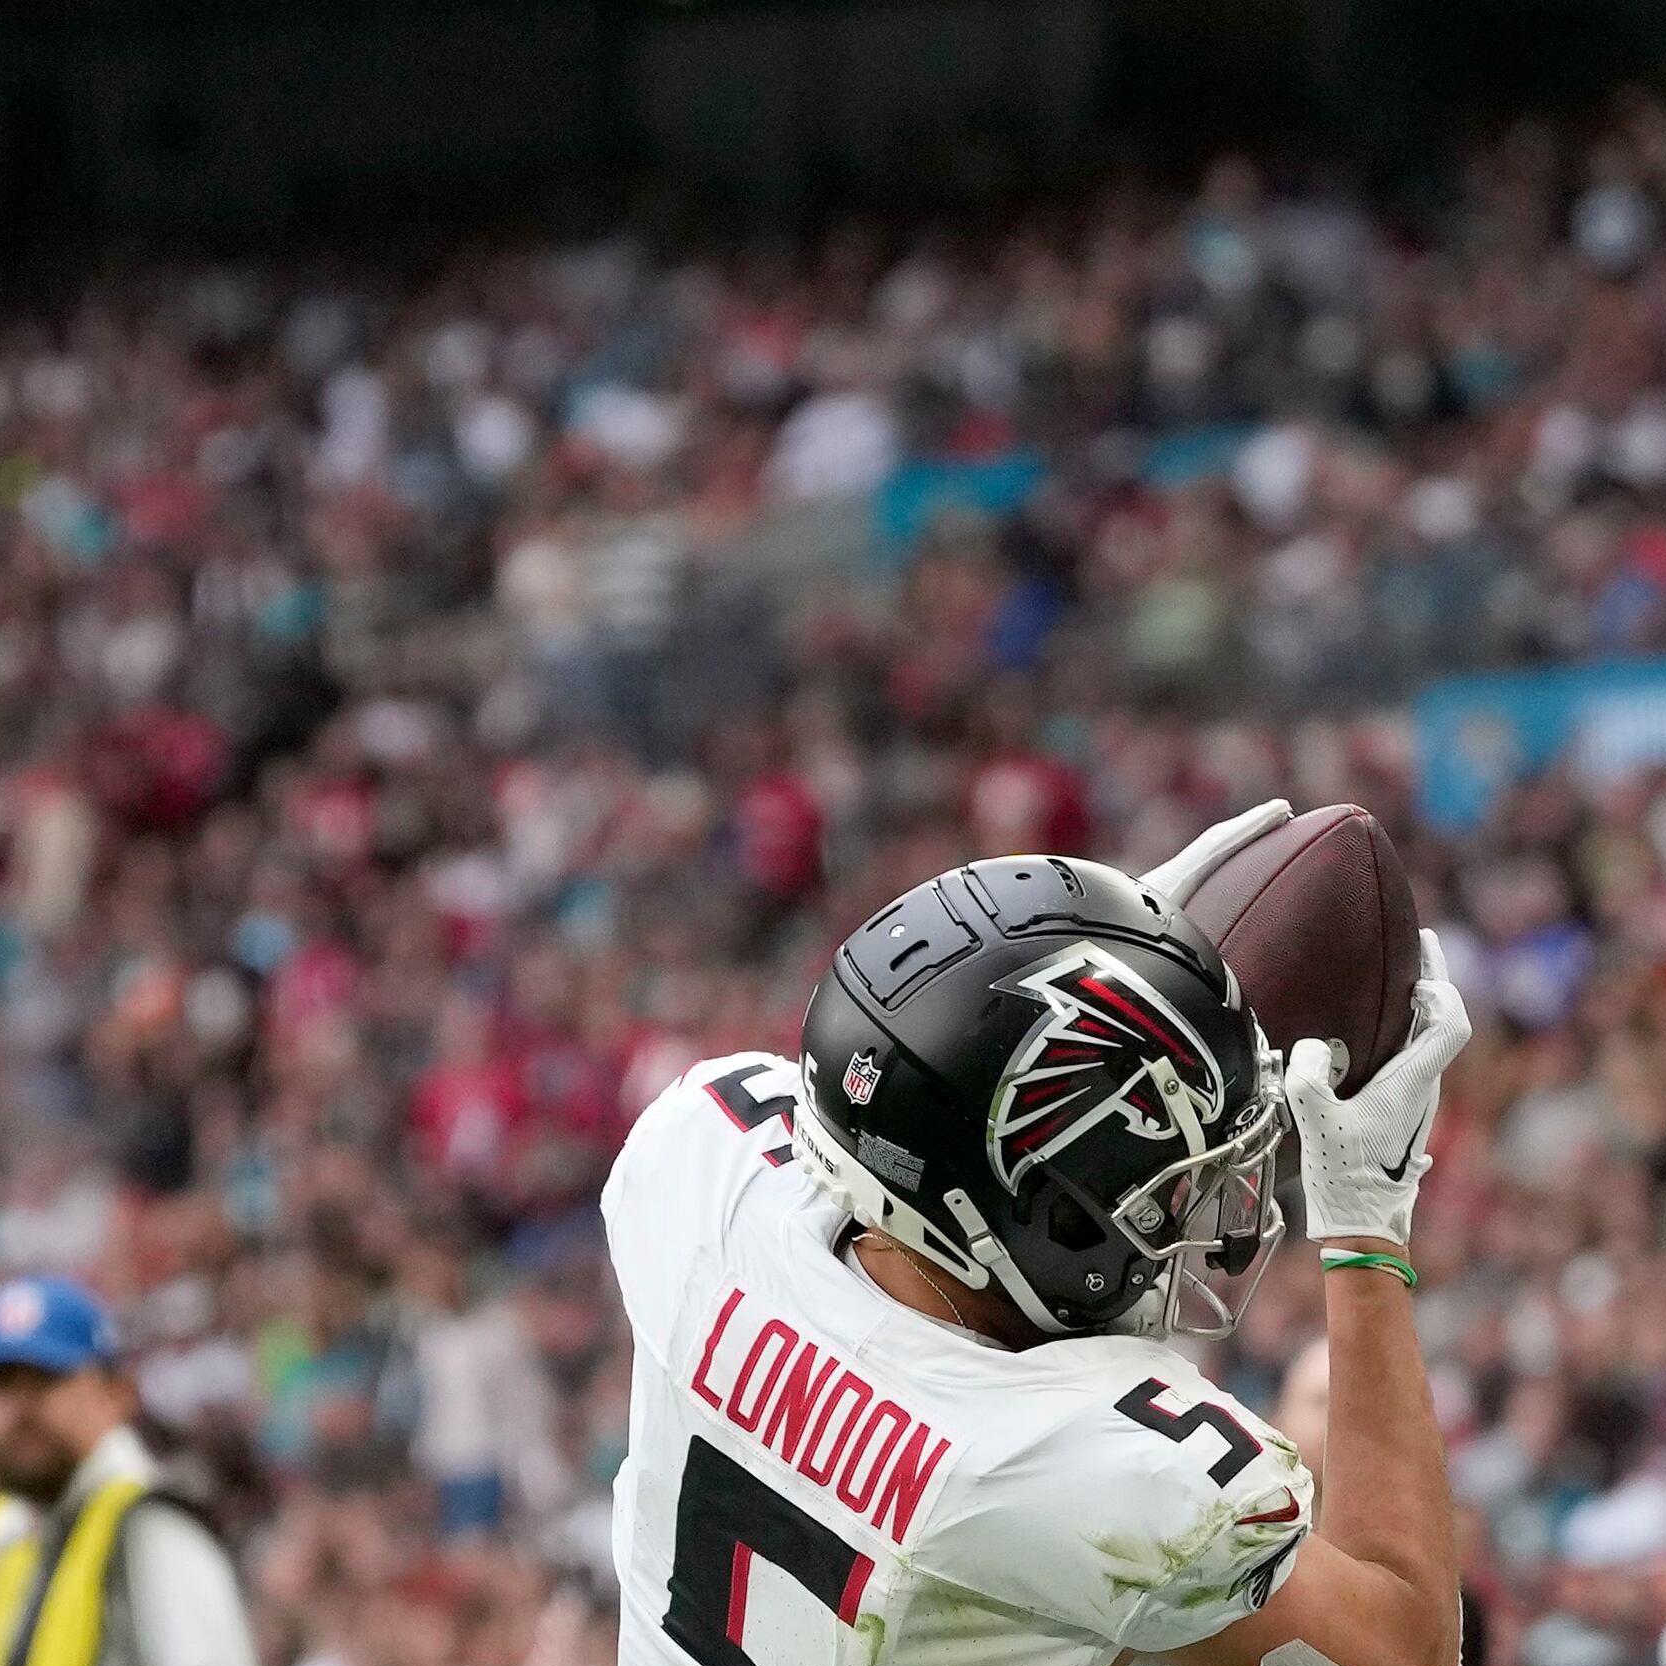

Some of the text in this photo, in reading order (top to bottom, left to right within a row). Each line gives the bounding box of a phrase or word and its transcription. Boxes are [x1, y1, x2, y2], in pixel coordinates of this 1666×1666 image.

[844, 1071, 869, 1100] NFL
[690, 1287, 952, 1545] LONDON
[1113, 1376, 1264, 1489] 5
